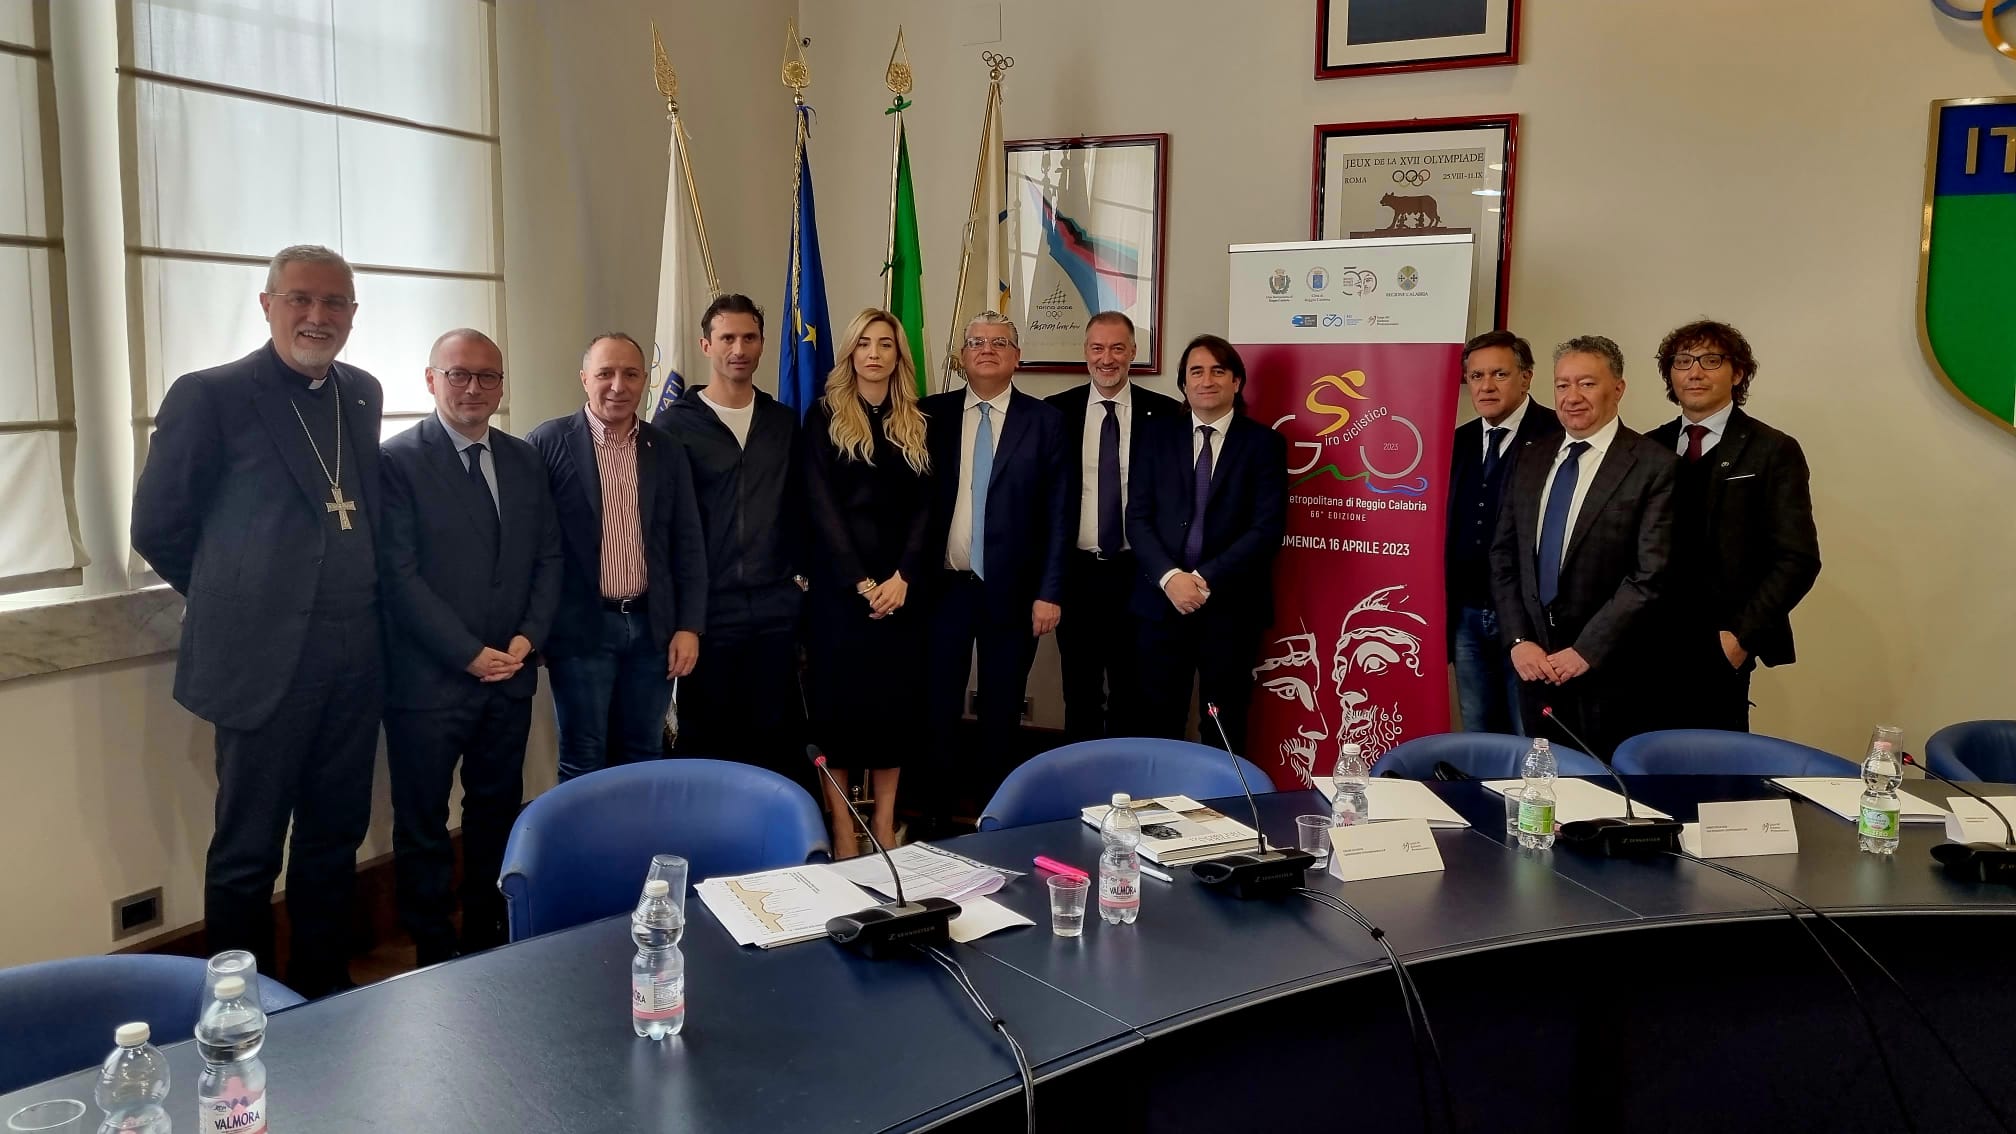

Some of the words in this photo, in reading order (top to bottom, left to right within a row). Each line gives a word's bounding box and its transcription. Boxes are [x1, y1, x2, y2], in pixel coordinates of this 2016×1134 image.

[1345, 158, 1371, 169] JEUX
[1374, 158, 1385, 166] DE
[1388, 157, 1397, 165] LA
[1400, 156, 1420, 166] XVII
[1423, 153, 1484, 165] OLYMPIADE
[1344, 176, 1367, 184] ROMA
[659, 379, 683, 412] ATI
[1343, 406, 1388, 442] ciclistico
[1383, 442, 1399, 451] 2023
[1289, 495, 1343, 508] etropolitana
[1346, 497, 1354, 508] di
[1355, 498, 1386, 511] Reggio
[1388, 499, 1427, 512] Calabria
[1328, 511, 1367, 522] EDIZIONE
[1281, 534, 1326, 550] MENICA
[1329, 538, 1340, 550] 16
[1342, 539, 1380, 554] APRILE
[1382, 542, 1410, 556] 2023
[1109, 885, 1137, 896] VALMORA
[214, 1111, 260, 1130] VALMORA
